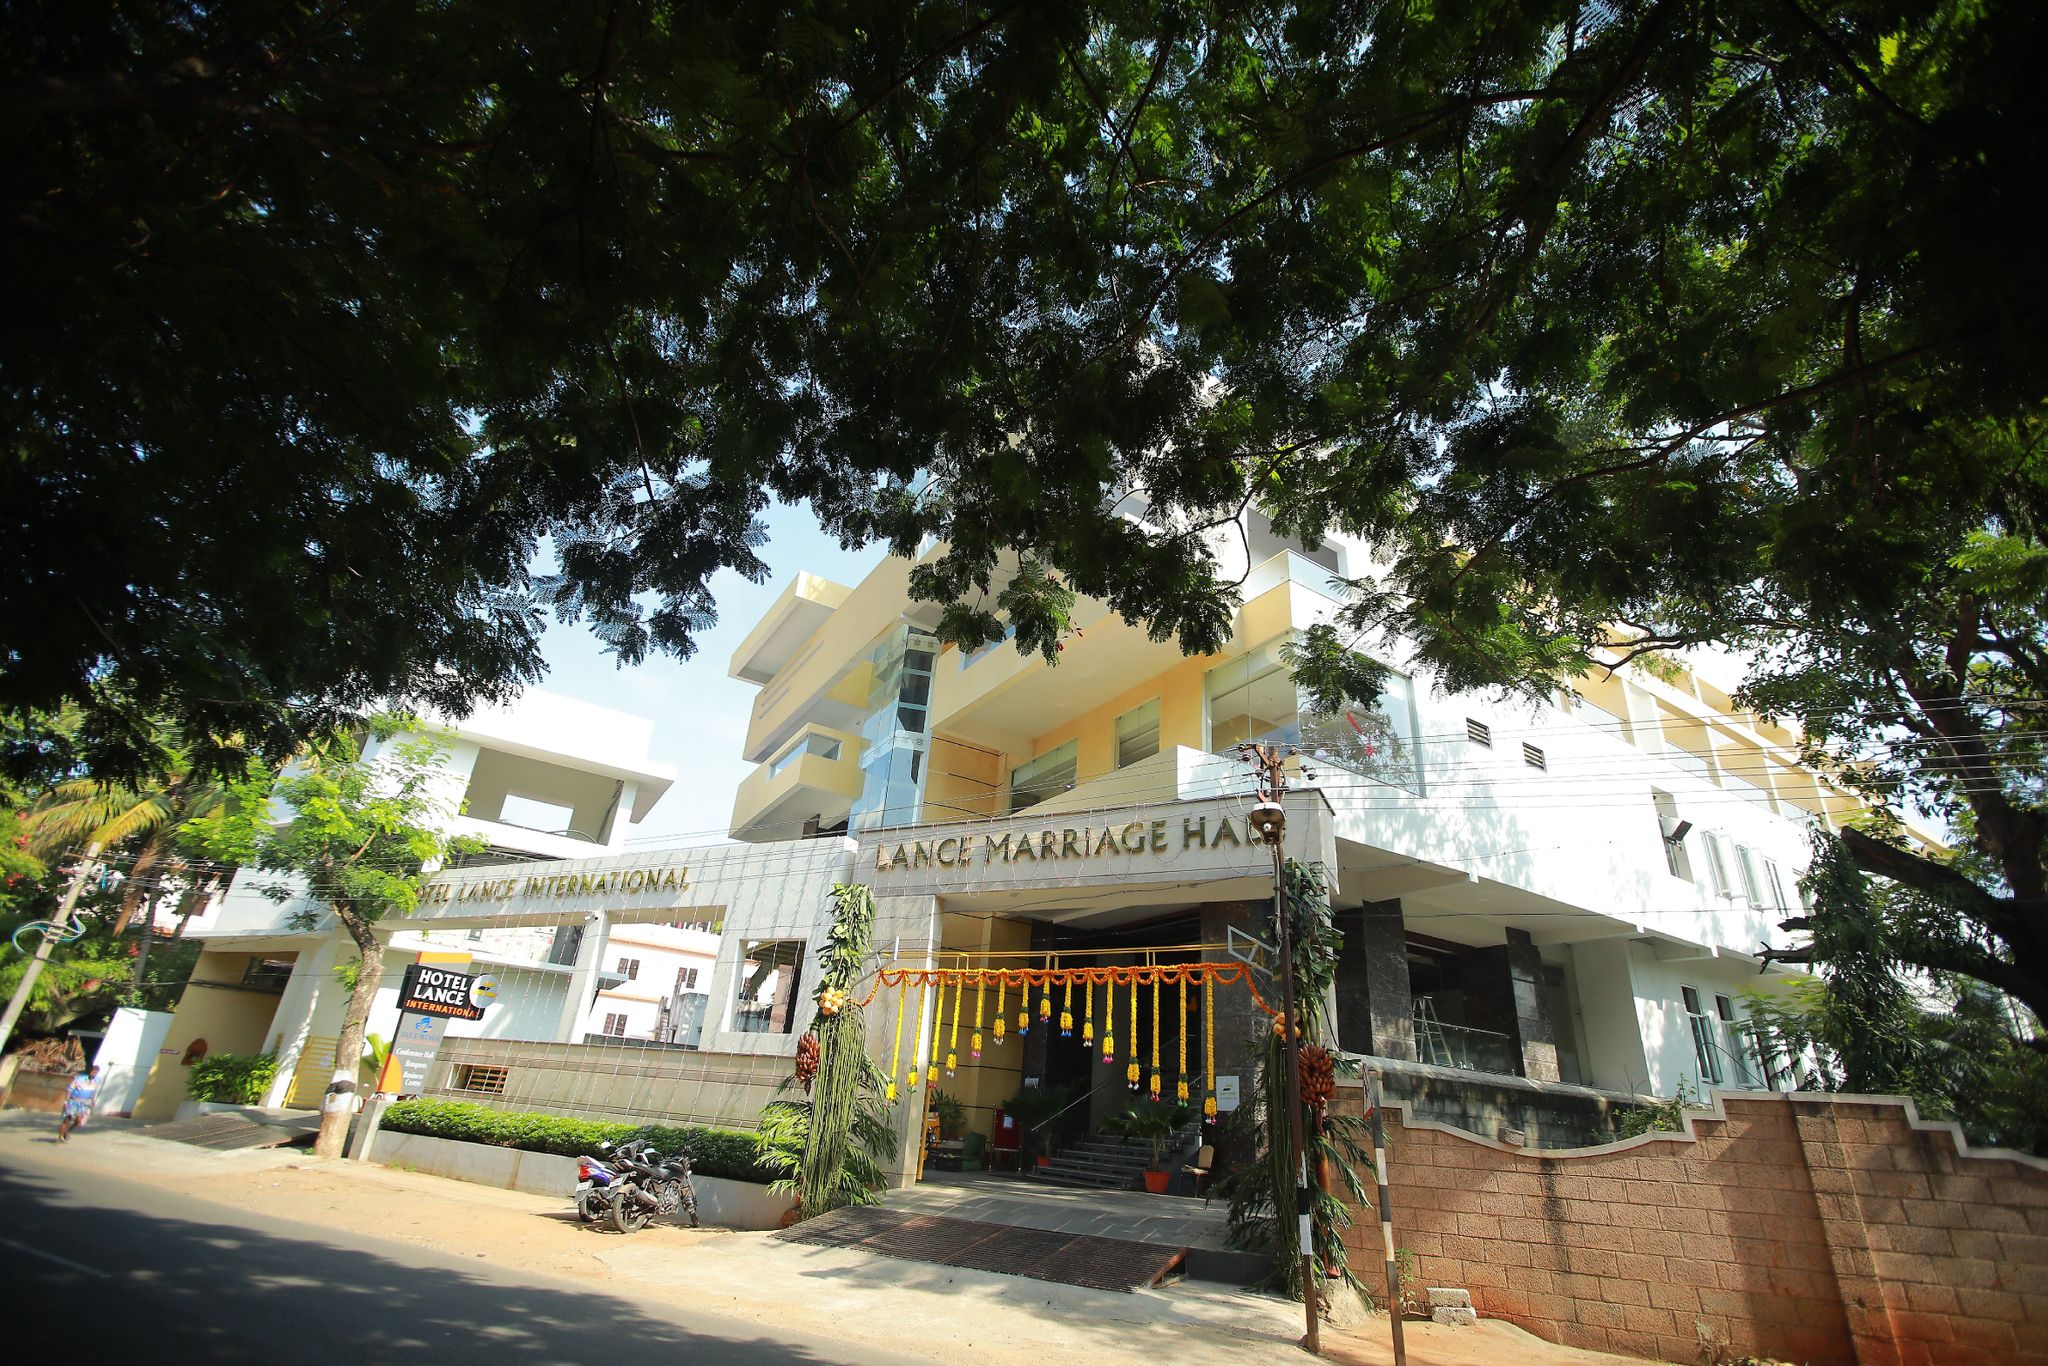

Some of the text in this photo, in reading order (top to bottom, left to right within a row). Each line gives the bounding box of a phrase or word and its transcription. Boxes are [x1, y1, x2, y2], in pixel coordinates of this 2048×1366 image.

[876, 812, 1286, 871] LANCE MARRIAGE HAL
[414, 866, 690, 904] OTEL LANCE INTERNATIONAL
[418, 969, 468, 991] HOTEL
[413, 984, 465, 1006] LANCE
[395, 1047, 435, 1059] Conference Hall
